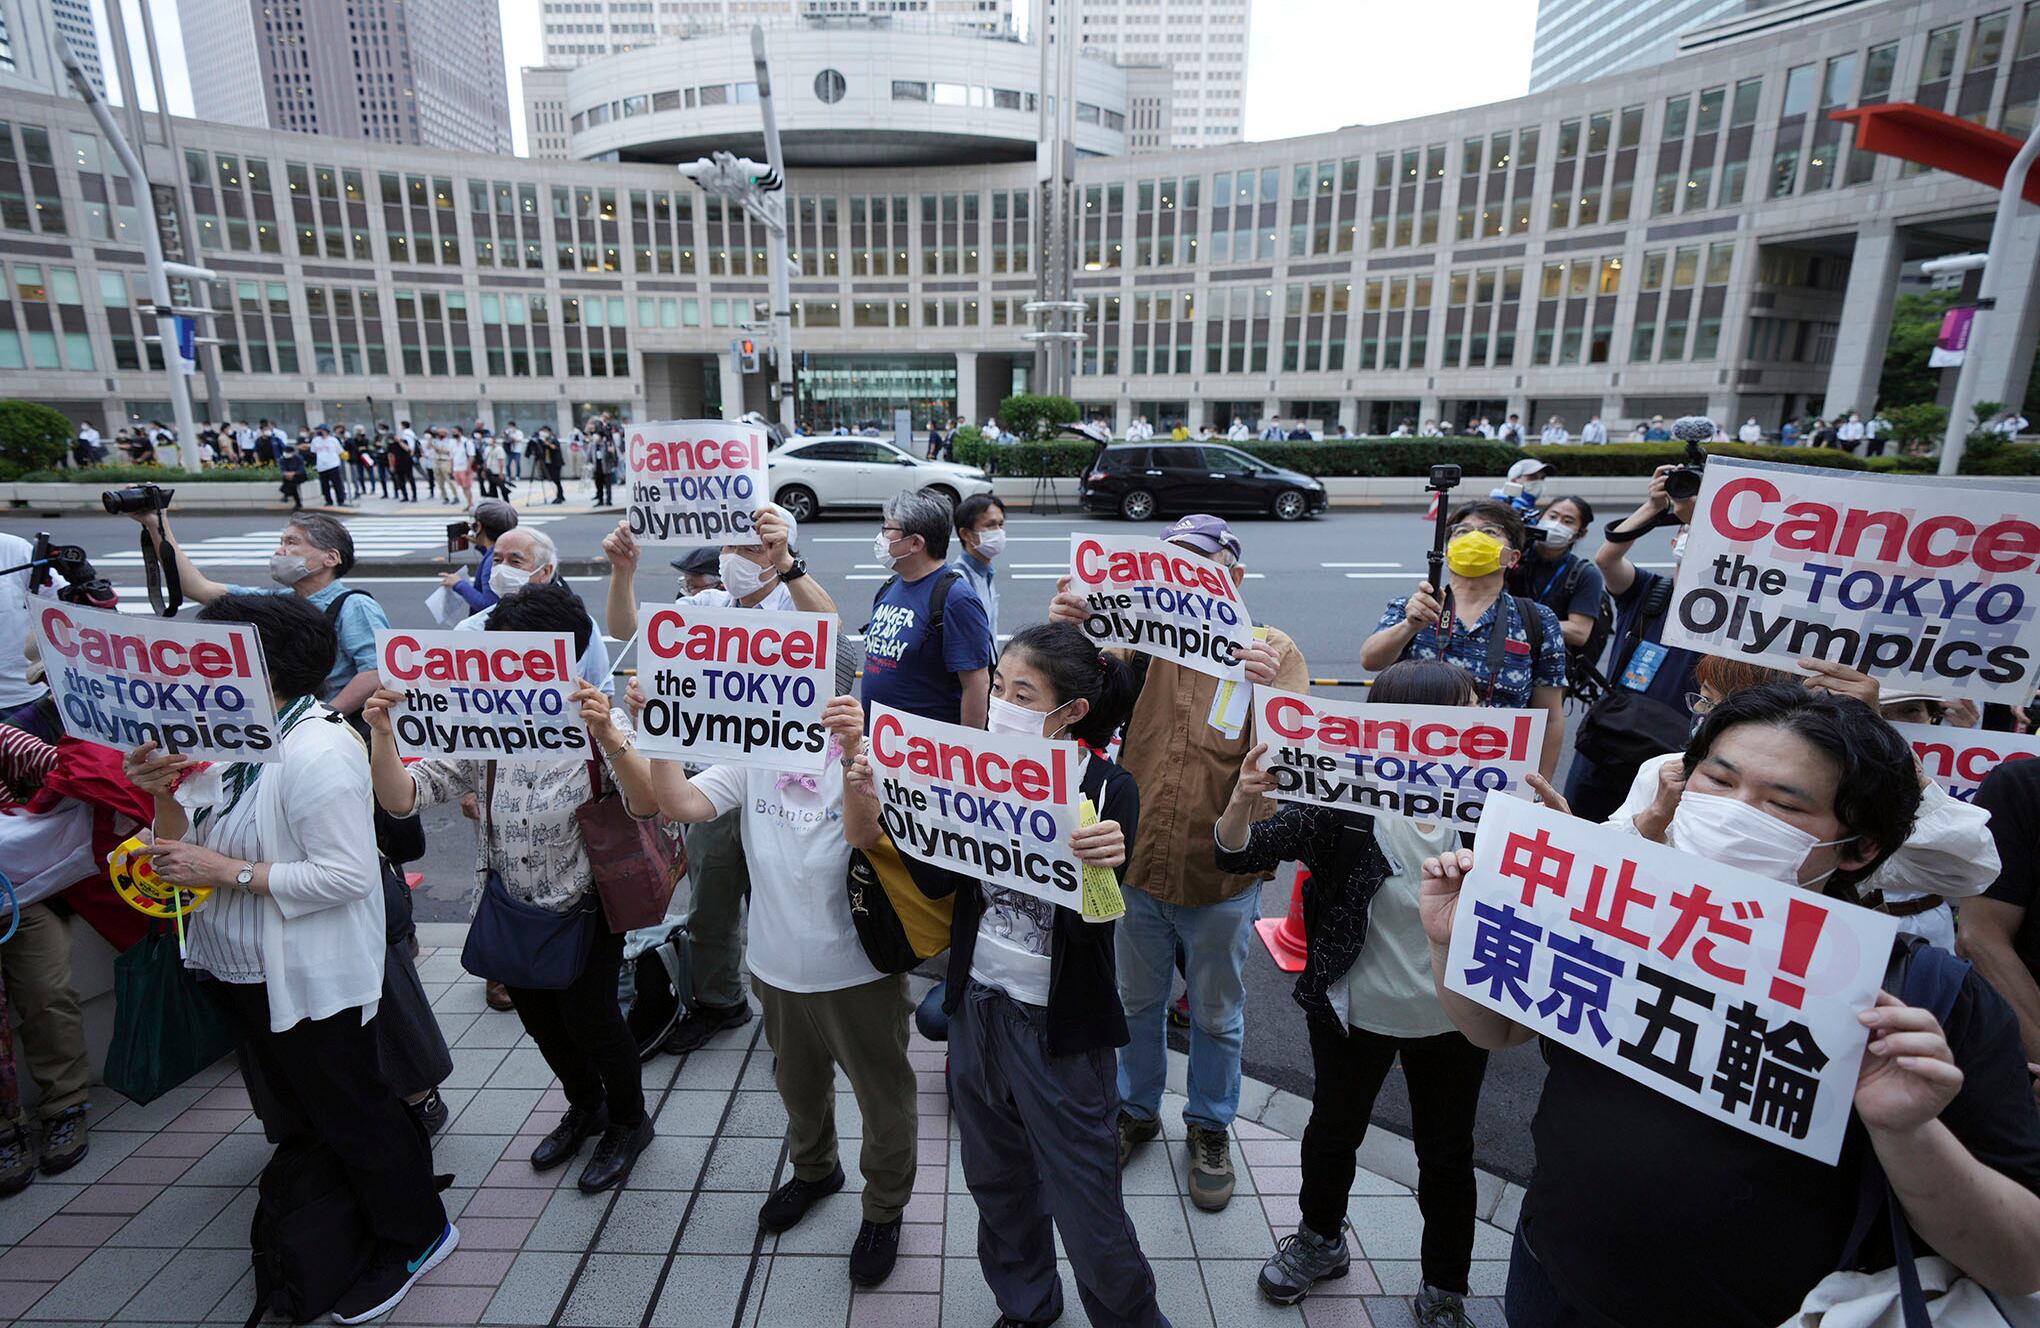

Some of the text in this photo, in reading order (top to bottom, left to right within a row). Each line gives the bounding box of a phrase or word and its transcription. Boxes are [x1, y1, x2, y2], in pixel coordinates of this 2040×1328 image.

[630, 433, 760, 472] Cancel
[633, 475, 753, 503] the TOKYO
[1710, 477, 2040, 574] Cance
[1076, 540, 1237, 603] Cancel
[1712, 554, 2025, 625] the TOKYO
[869, 621, 902, 638] IS AN
[872, 604, 914, 628] ANGER
[1087, 586, 1238, 626] the TOKYO
[1440, 610, 1451, 629] EOS
[41, 608, 252, 679] Cancel
[385, 635, 570, 683] Cancel
[647, 610, 829, 670] Cancel
[1083, 613, 1245, 667] Olympics
[1679, 588, 2031, 684] Olympics
[64, 667, 245, 712] the TOKYO
[404, 687, 563, 716] the TOKYO
[655, 669, 816, 708] the TOKYO
[63, 693, 273, 755] Olympics
[396, 715, 586, 754] Olympics
[643, 698, 826, 753] Olympics
[1265, 696, 1533, 762] Cancel
[872, 713, 1068, 805] Cancel
[1279, 747, 1508, 793] the TOKYO
[883, 778, 1057, 843] the TOKYO
[1266, 765, 1483, 824] Olympic
[882, 802, 1078, 893] Olympics
[1498, 828, 1829, 1010] 中止だ！
[1463, 900, 1830, 1140] 東京五輪
